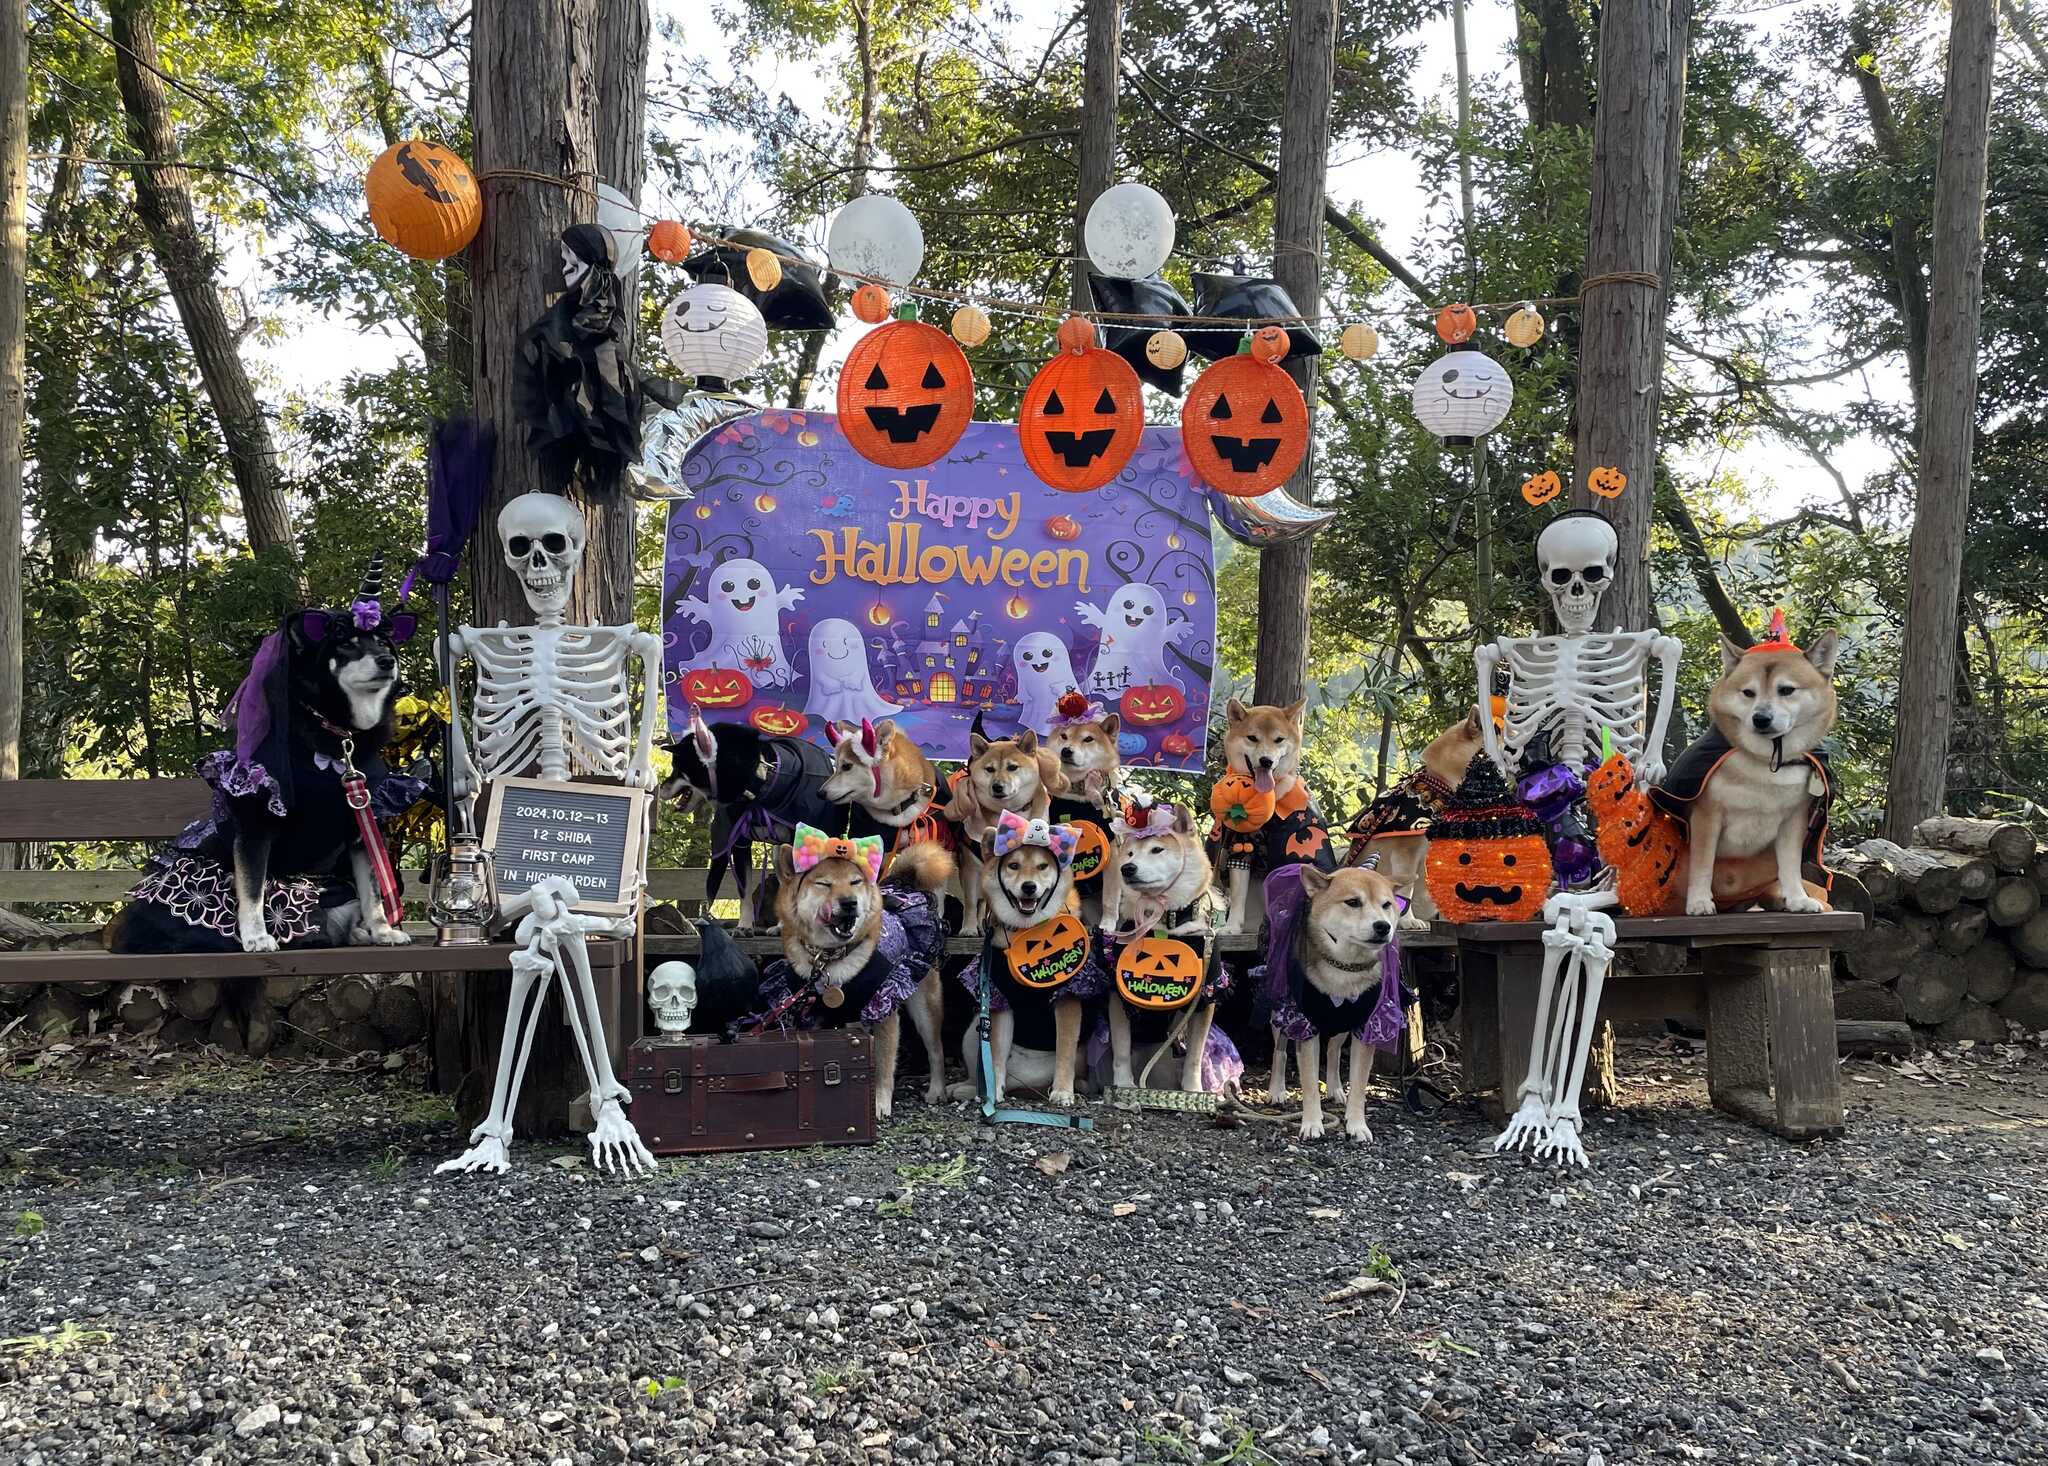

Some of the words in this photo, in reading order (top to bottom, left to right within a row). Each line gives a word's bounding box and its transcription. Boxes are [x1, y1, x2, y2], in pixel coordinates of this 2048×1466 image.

[888, 479, 1021, 540] Happy
[806, 521, 1091, 594] Halloween
[533, 828, 549, 841] 12
[556, 831, 592, 844] SHIBA
[522, 849, 557, 862] FIRST
[561, 852, 595, 866] CAMP
[503, 869, 517, 881] IN
[1030, 946, 1083, 981] HALLOWEEN
[1128, 979, 1188, 997] HALLOWEEN
